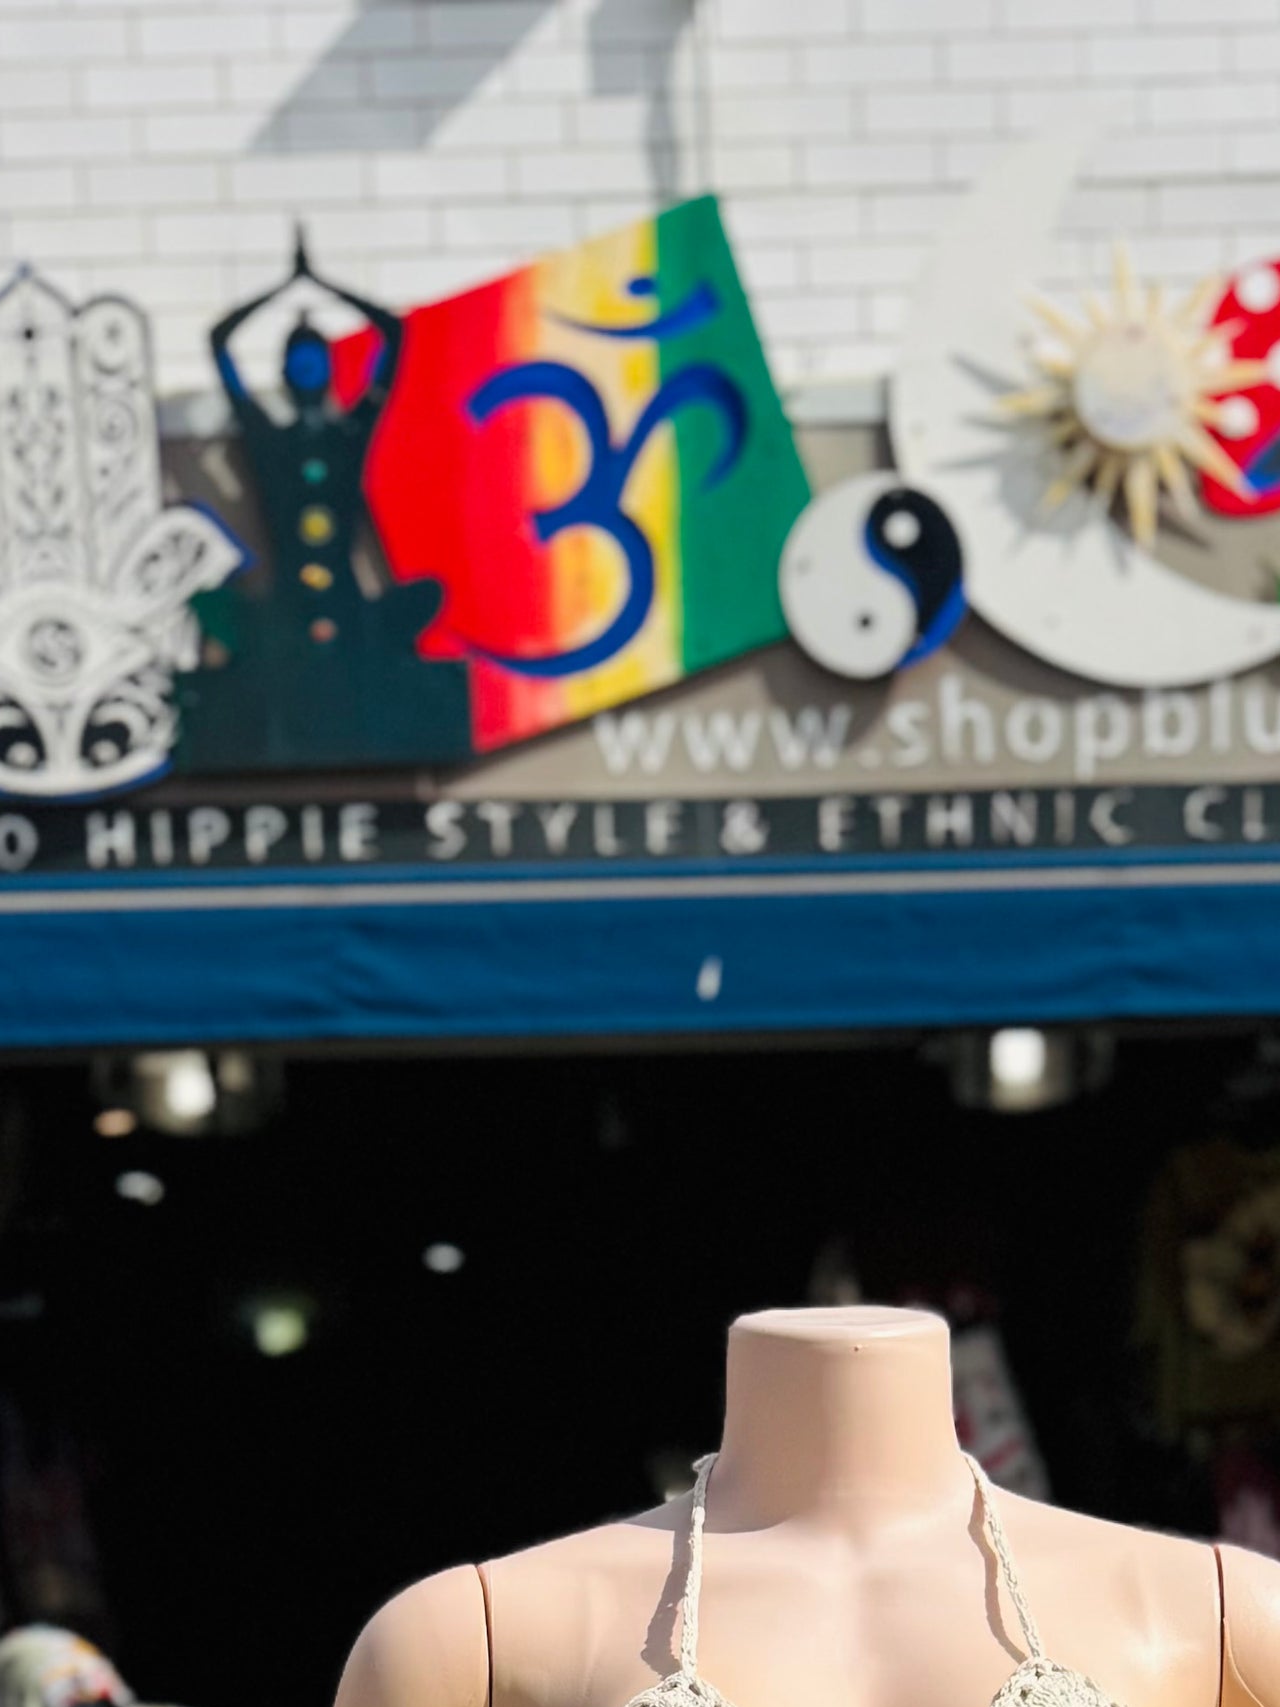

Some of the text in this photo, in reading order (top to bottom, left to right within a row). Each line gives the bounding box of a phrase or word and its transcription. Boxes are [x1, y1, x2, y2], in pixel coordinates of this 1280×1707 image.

[86, 802, 380, 868] HIPPIE
[424, 799, 684, 860] STYLE
[721, 798, 767, 856] &
[819, 790, 1135, 852] ETHNIC
